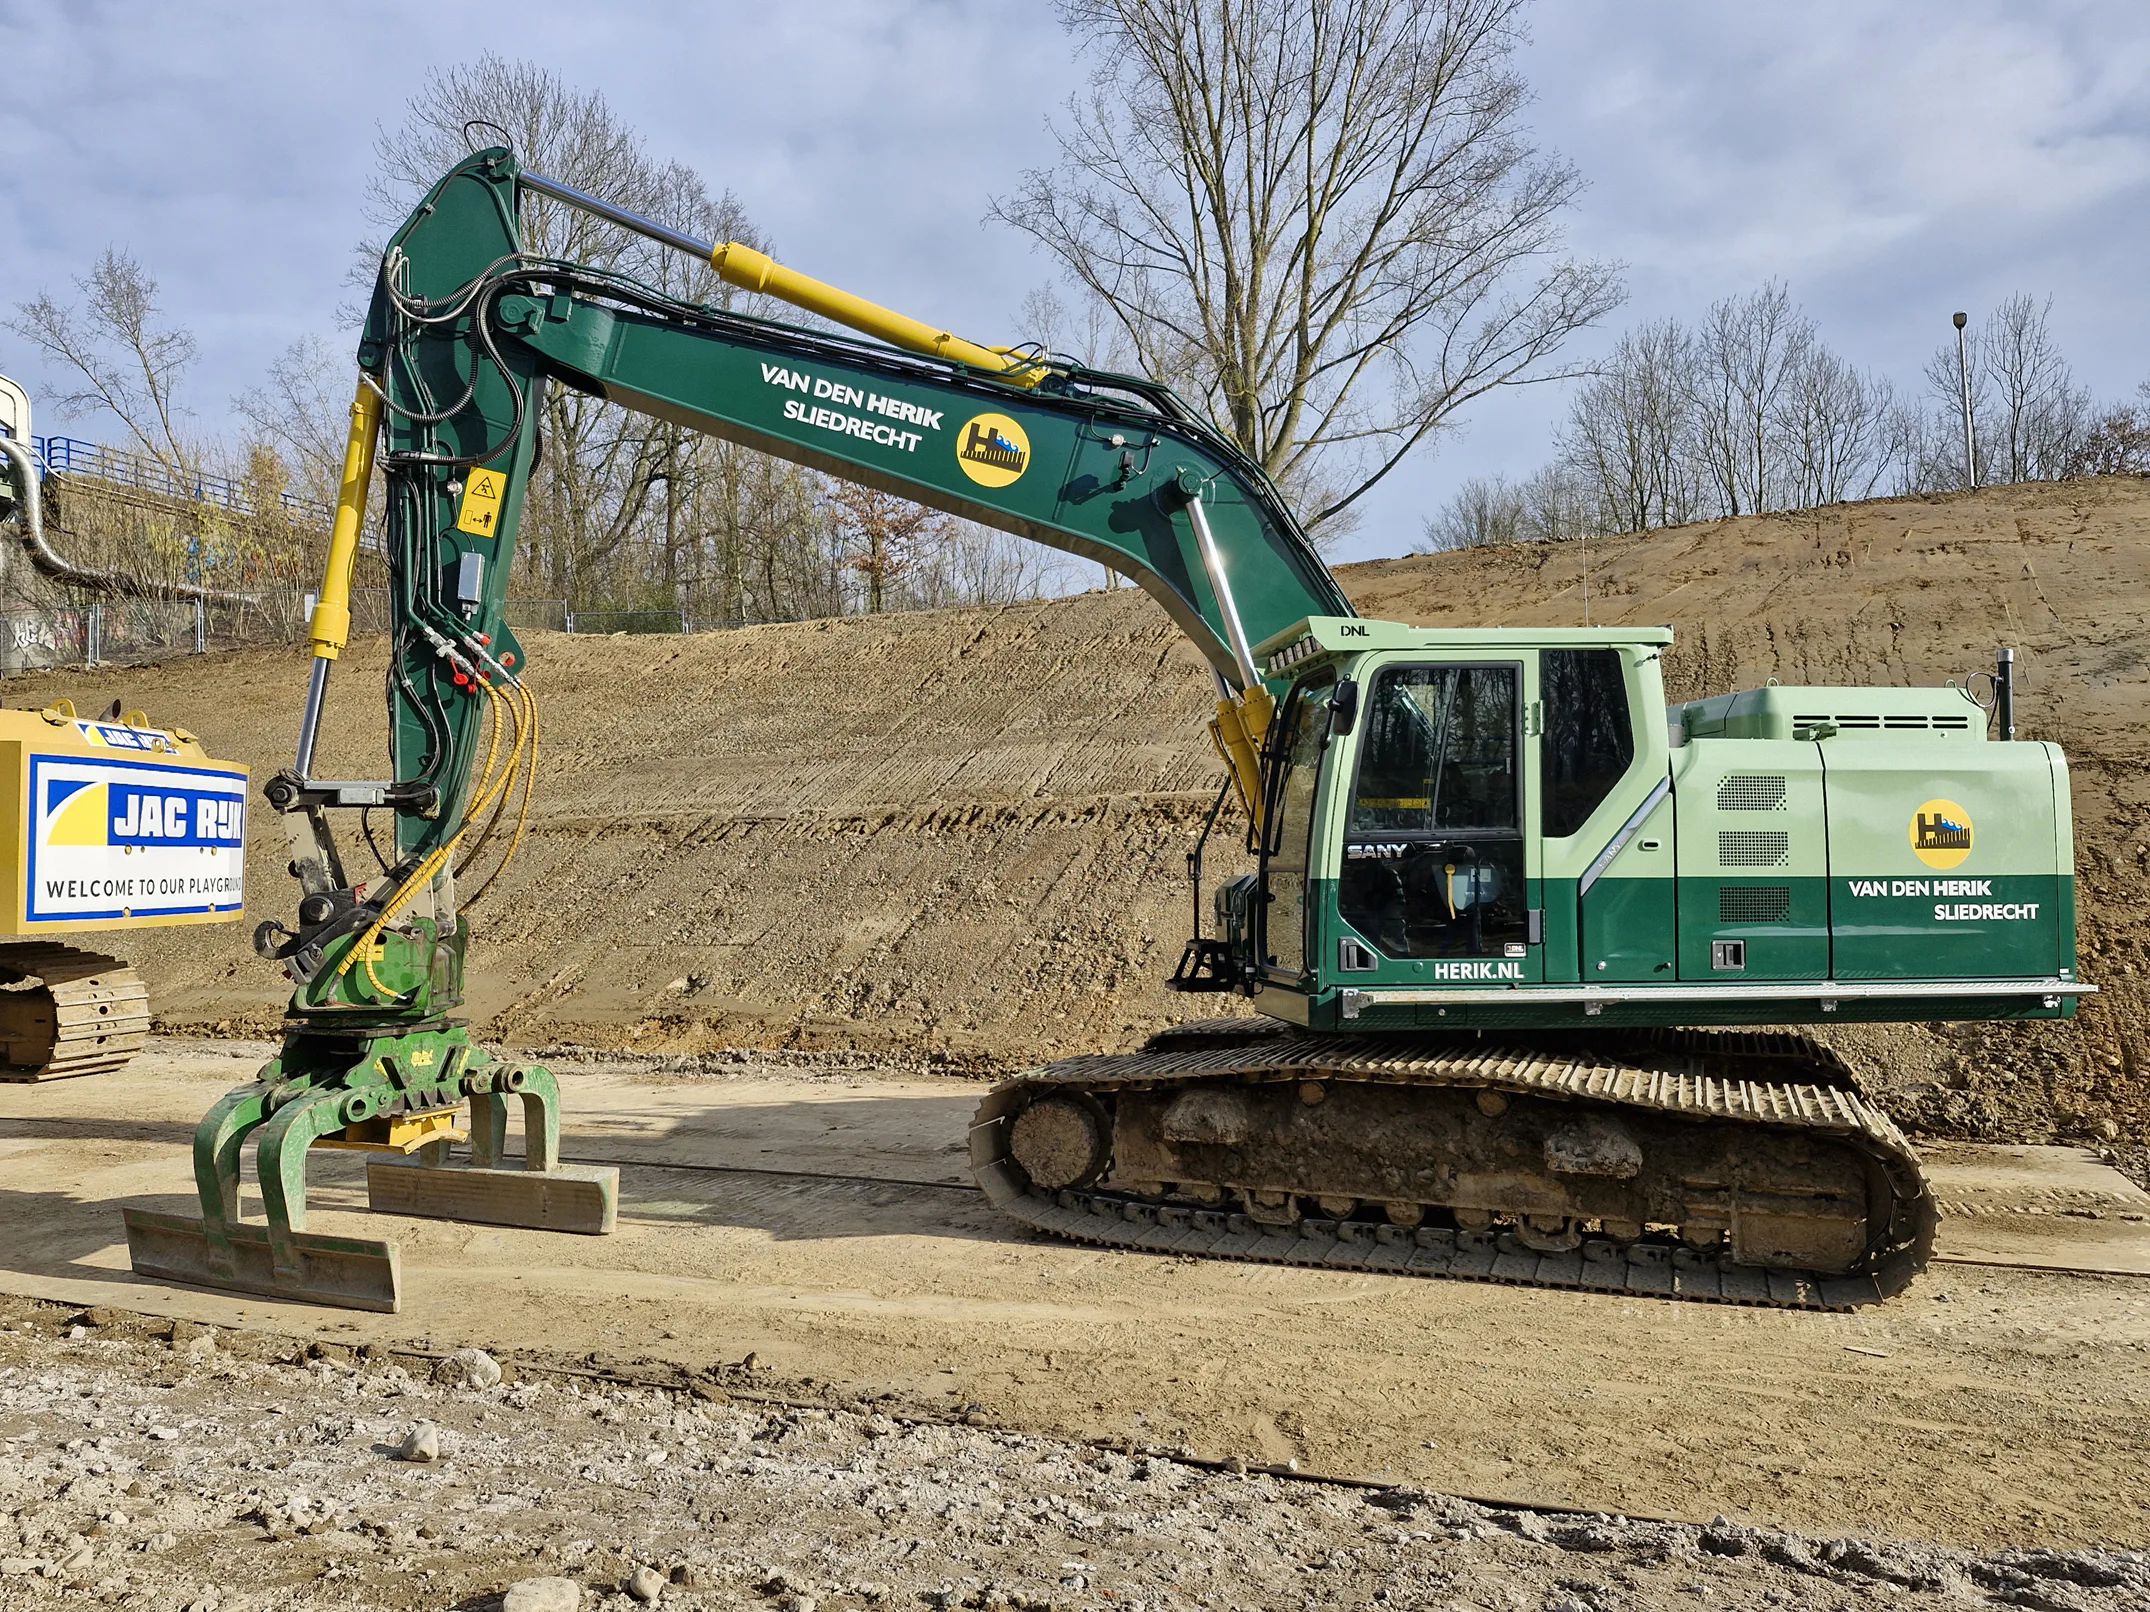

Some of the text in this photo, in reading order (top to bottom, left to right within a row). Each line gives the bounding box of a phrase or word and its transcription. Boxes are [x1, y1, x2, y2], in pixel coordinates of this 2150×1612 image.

[760, 363, 944, 431] VAN DEN HERIK
[783, 400, 923, 453] SLIEDRECHT
[1340, 625, 1370, 637] DNL
[104, 729, 140, 748] JAC
[113, 793, 188, 838] JAC
[1347, 843, 1408, 860] SANY
[46, 879, 134, 899] WELCOME
[139, 878, 156, 896] TO
[159, 877, 185, 895] OUR
[1848, 880, 1992, 897] VAN DEN HERIK
[1934, 903, 2040, 921] SLIEDRECHT
[1434, 962, 1525, 980] HERIK.NL
